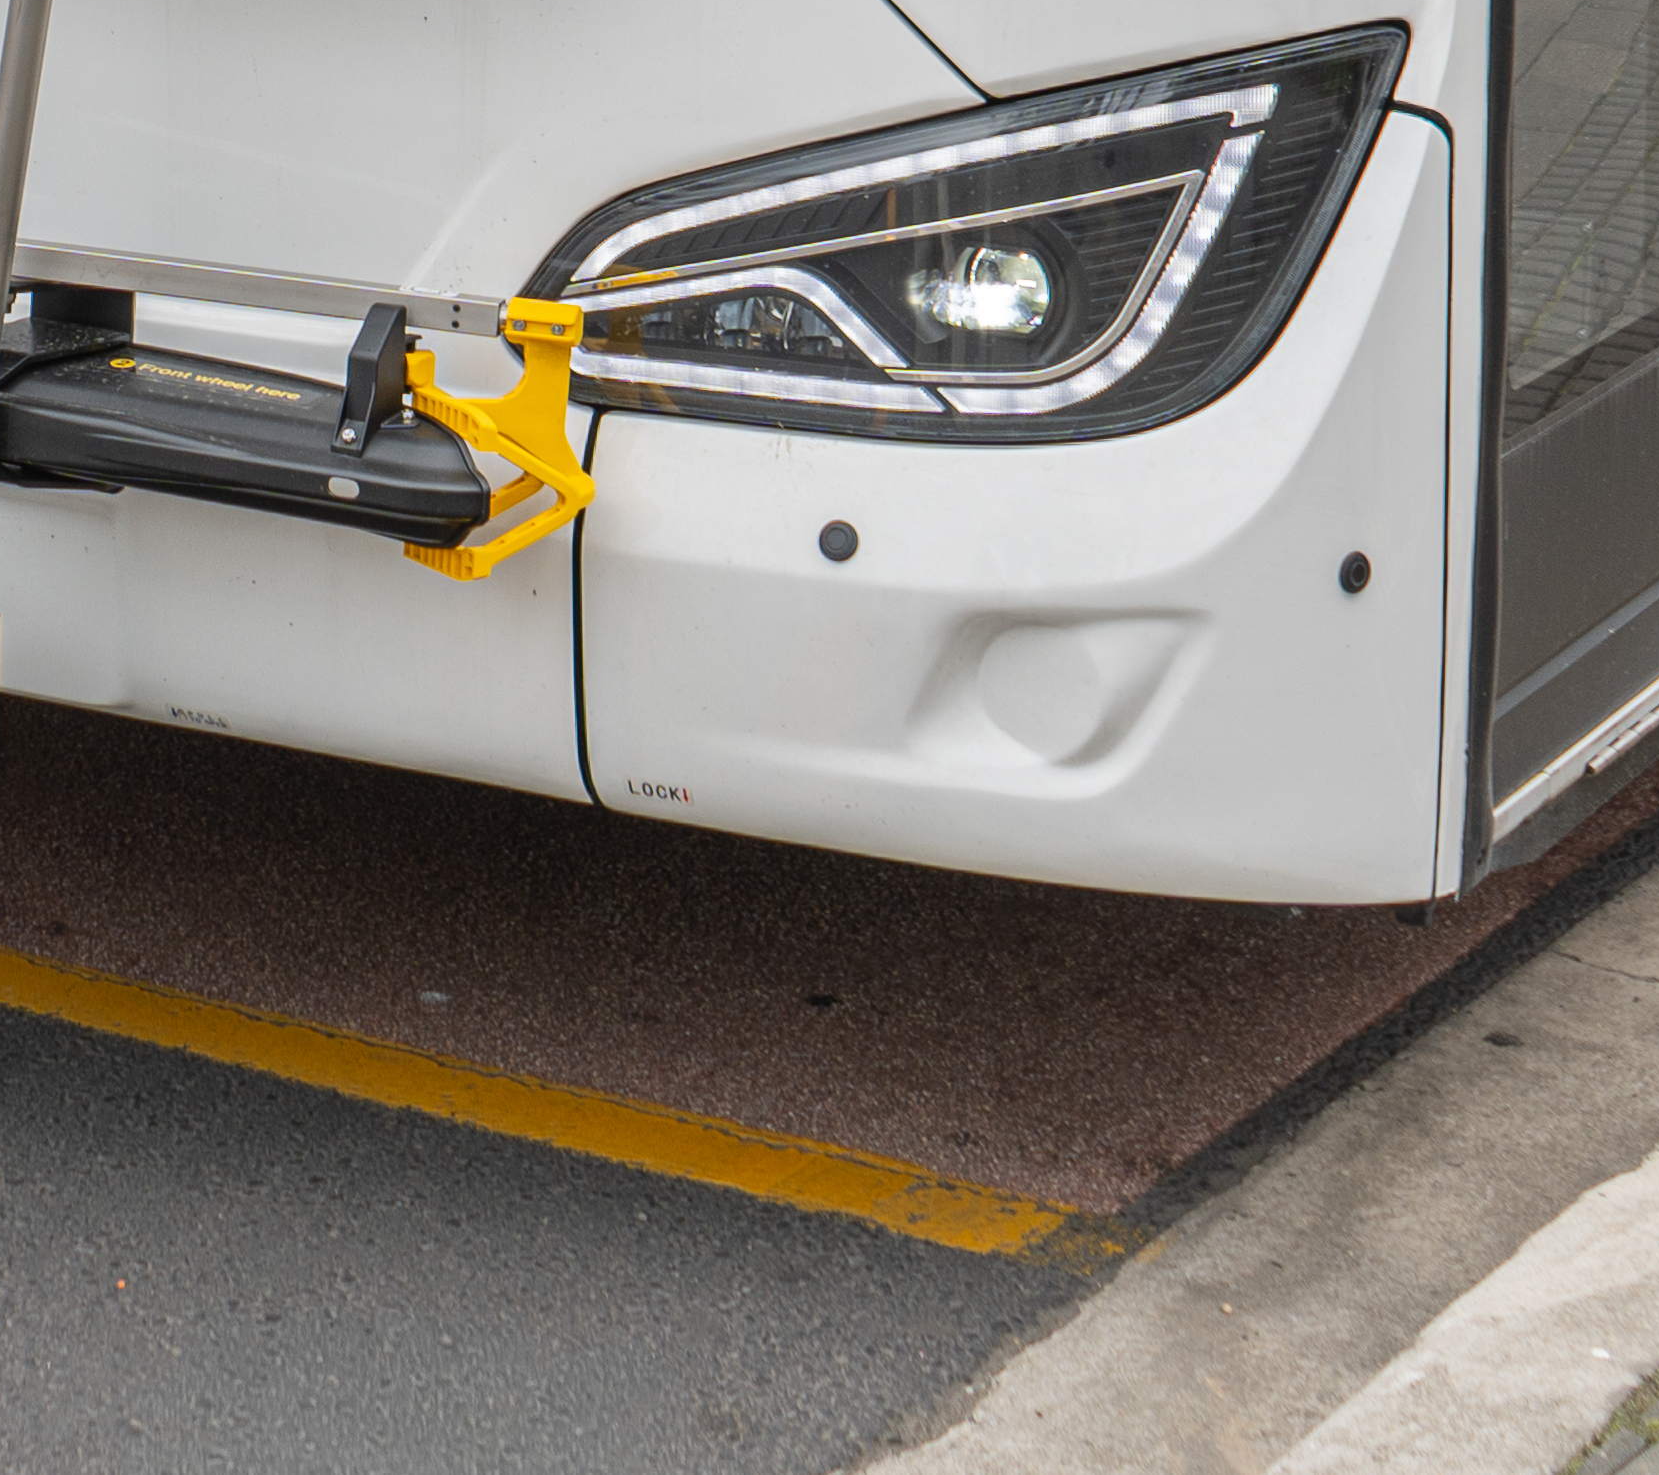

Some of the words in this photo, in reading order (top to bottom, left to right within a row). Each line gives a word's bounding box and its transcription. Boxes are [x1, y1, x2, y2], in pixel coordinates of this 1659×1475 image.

[138, 362, 193, 380] Front
[194, 373, 254, 392] wheel
[255, 385, 302, 401] here
